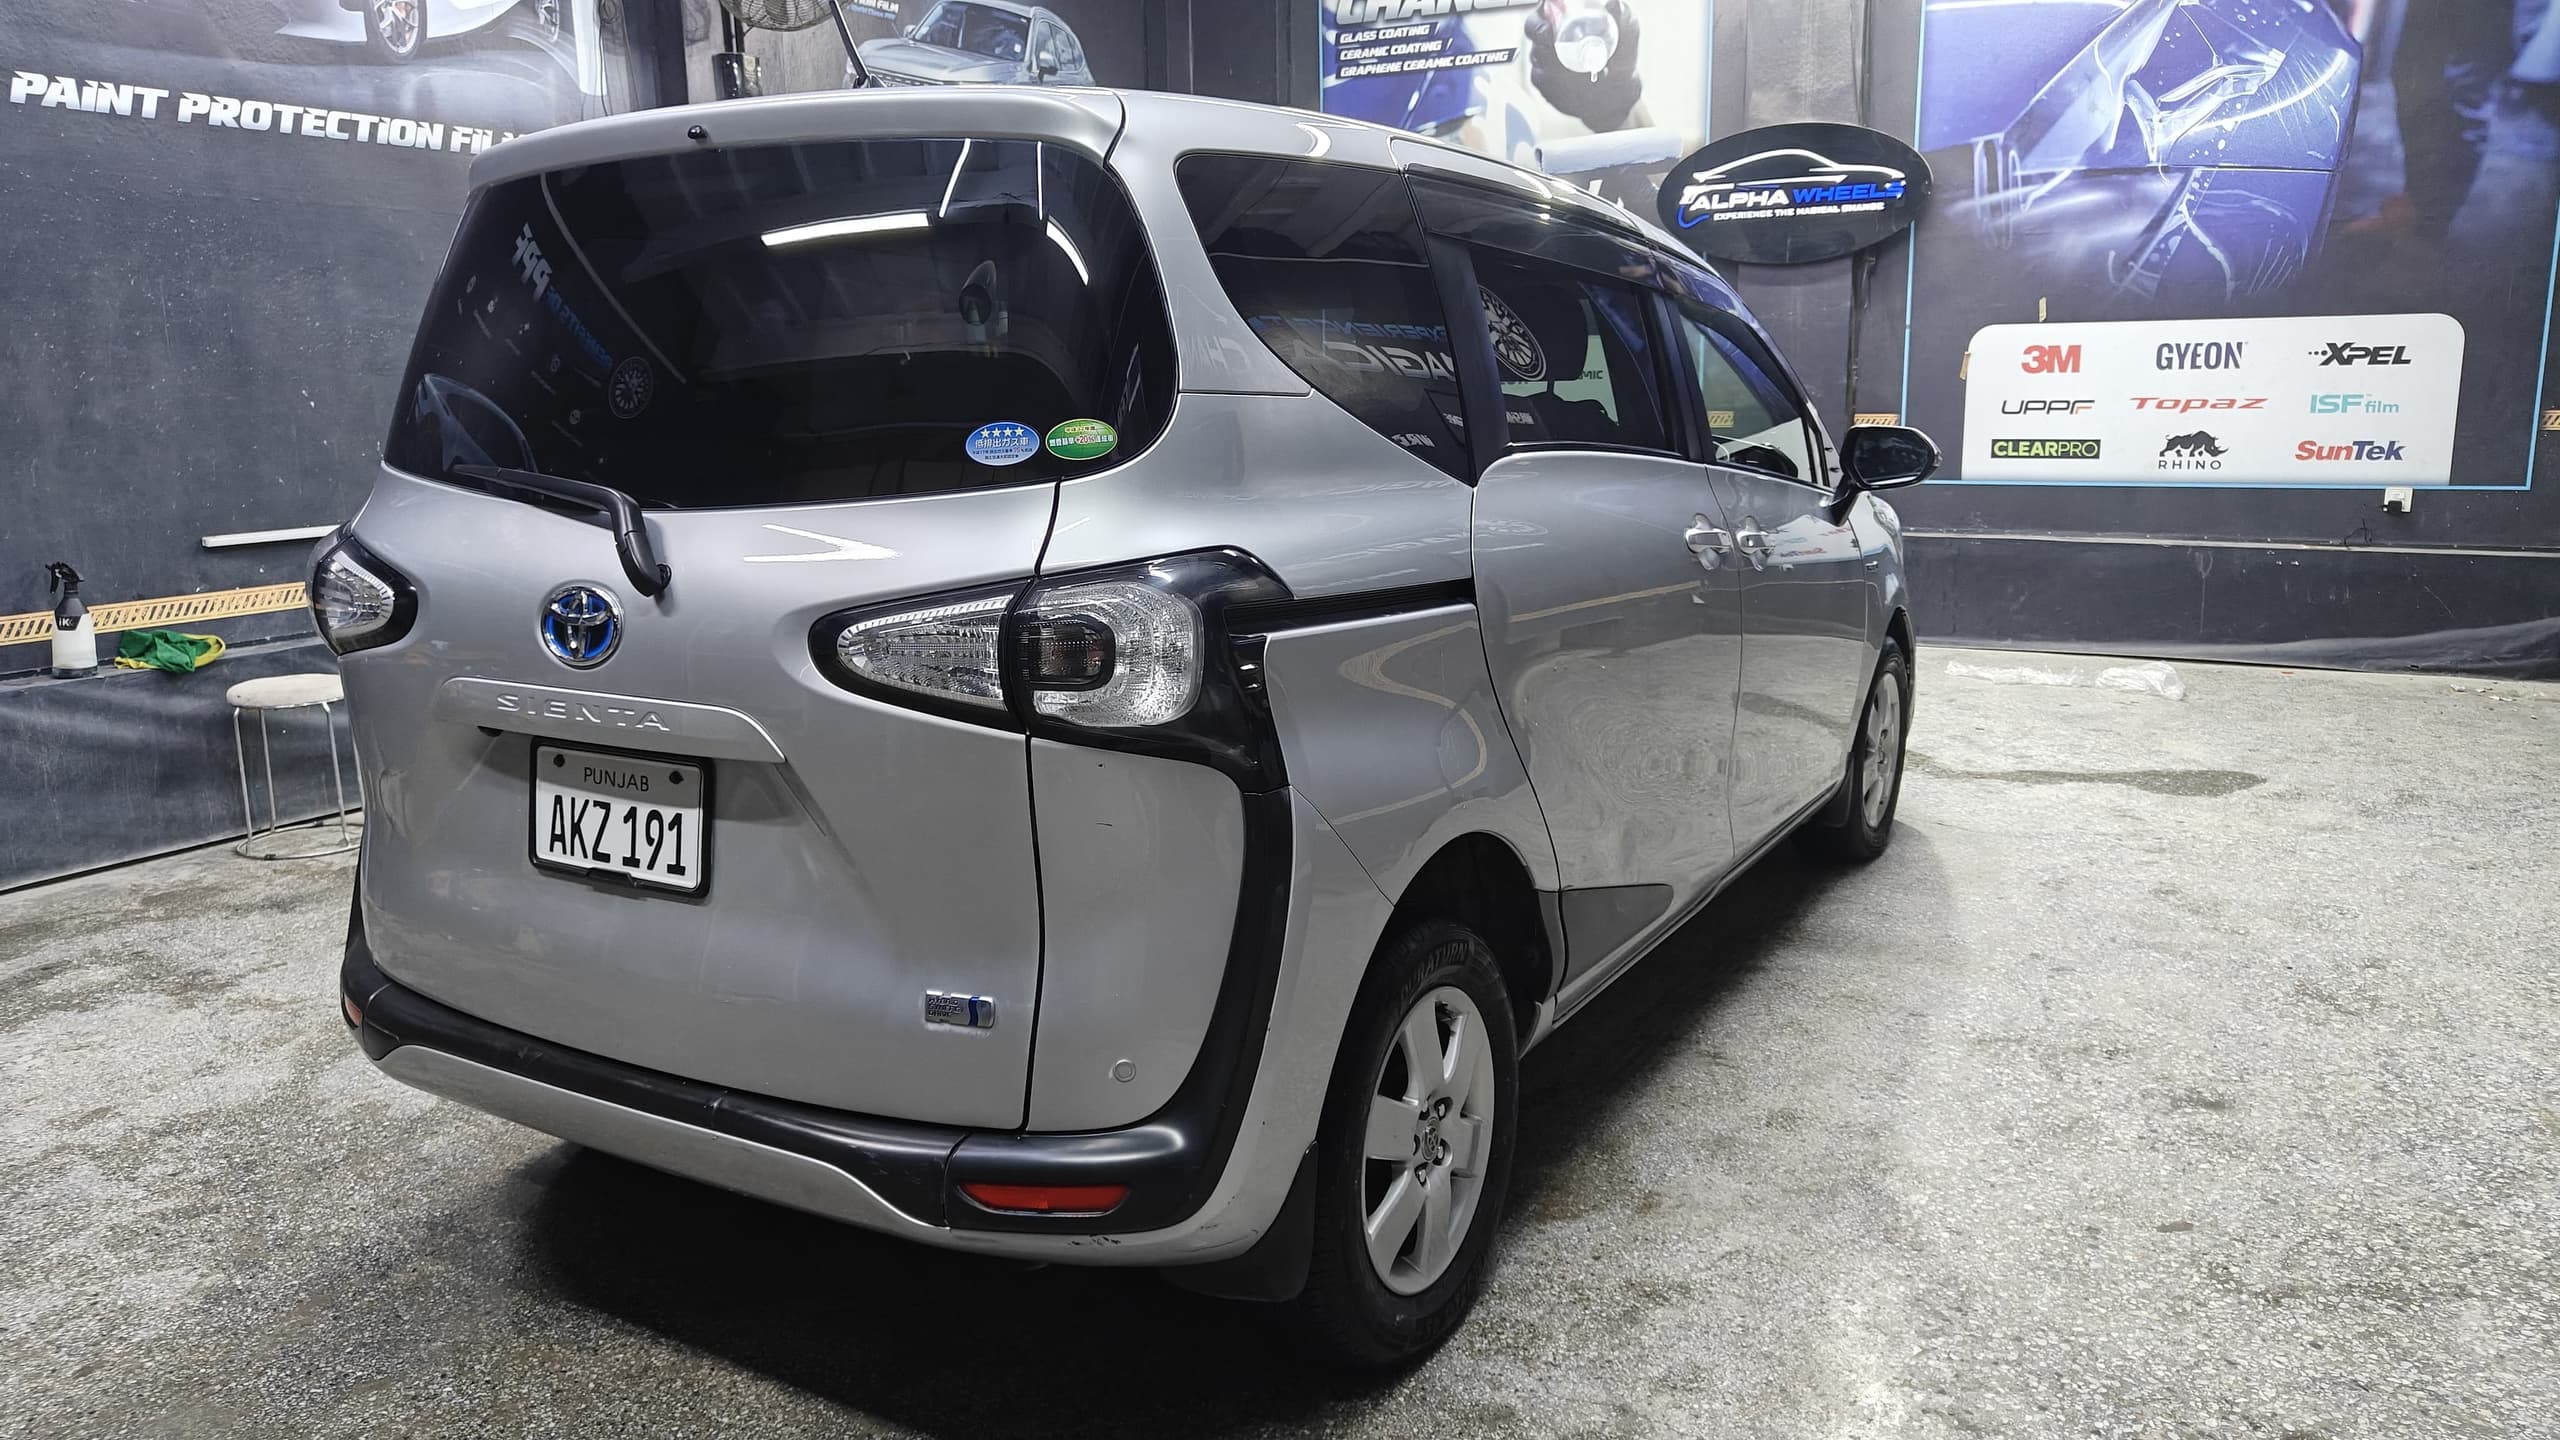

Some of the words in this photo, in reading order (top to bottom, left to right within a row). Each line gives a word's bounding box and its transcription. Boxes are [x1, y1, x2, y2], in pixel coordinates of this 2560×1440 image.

[1340, 30, 1377, 44] GLASS
[1378, 25, 1430, 39] COATING
[1340, 46, 1389, 60] CERAMIC
[1390, 40, 1442, 55] COATING
[1340, 61, 1402, 77] GRAPHENE
[1403, 56, 1454, 71] CERAMIC
[1455, 51, 1509, 66] COATING
[10, 70, 170, 119] PAINT
[177, 91, 444, 151] PROTECTION
[450, 125, 527, 155] FIL
[1689, 188, 1790, 211] ALPHA
[1792, 179, 1906, 203] WHEELS
[1775, 207, 1795, 217] THE
[2021, 344, 2082, 374] 3M
[2156, 341, 2243, 371] GYEON
[2318, 342, 2412, 366] XPEL
[2001, 399, 2095, 415] UPPF
[2130, 396, 2268, 414] Topaz
[2310, 393, 2364, 414] ISF
[2365, 400, 2399, 413] film
[1993, 440, 2098, 457] CLEARPRO
[2295, 440, 2407, 461] SunTek
[2158, 459, 2222, 470] RHINO
[496, 693, 671, 732] SIENTA
[583, 766, 650, 793] PUNJAB
[549, 794, 612, 865] AKZ
[621, 805, 687, 877] 191
